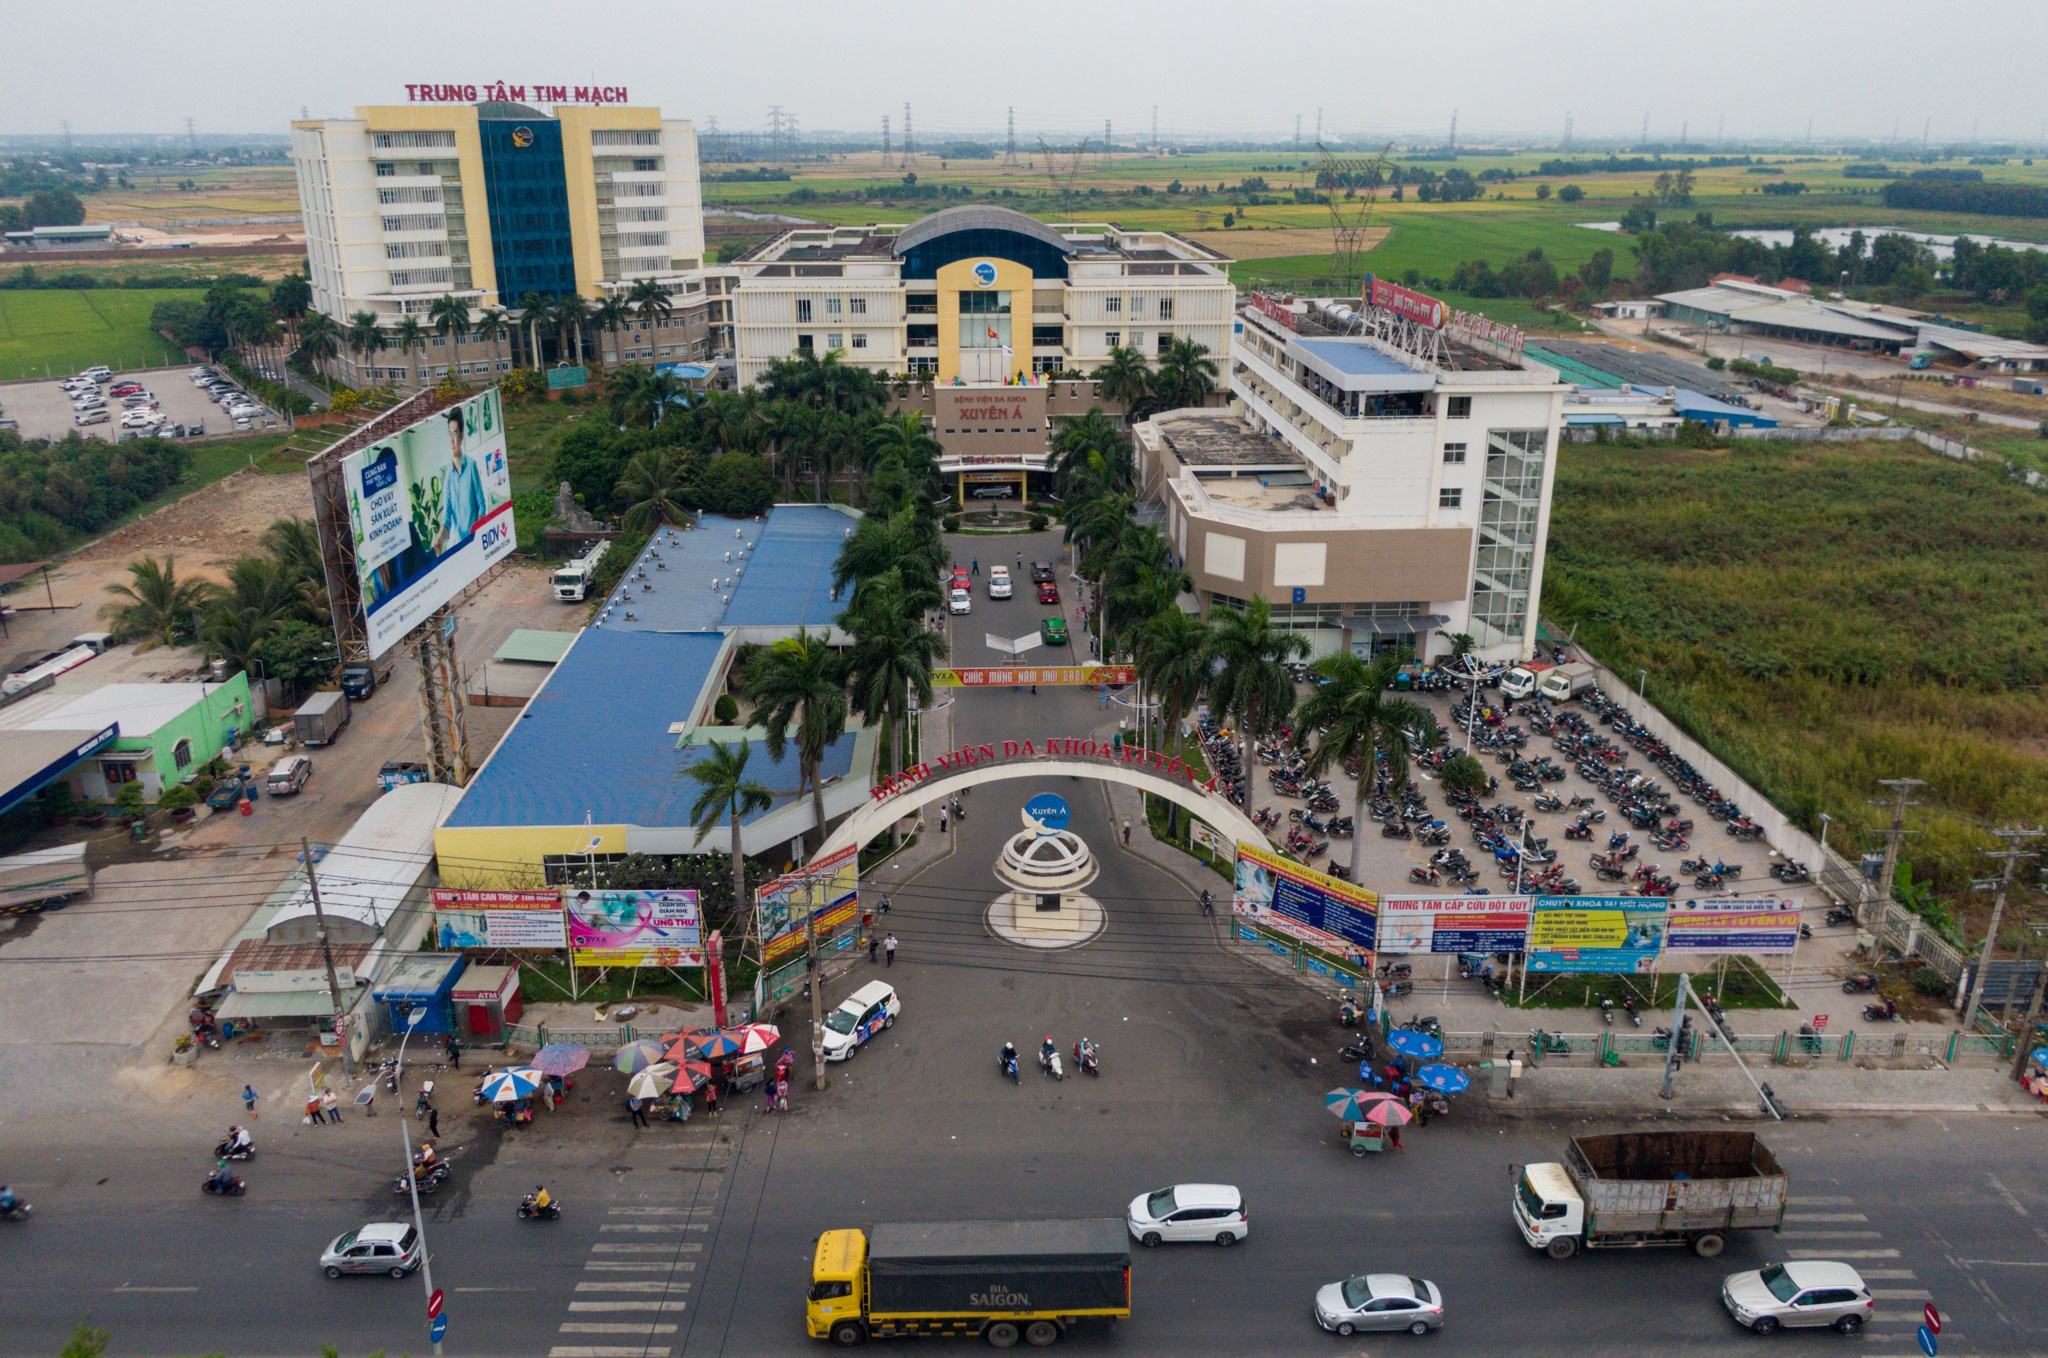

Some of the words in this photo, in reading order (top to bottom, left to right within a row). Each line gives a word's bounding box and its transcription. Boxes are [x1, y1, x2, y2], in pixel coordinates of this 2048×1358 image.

[405, 84, 477, 101] TRUNG
[483, 80, 526, 102] TÂM
[533, 86, 567, 102] TIM
[574, 86, 628, 106] MẠCH
[954, 396, 974, 404] BỆNH
[976, 395, 992, 403] VIỆN
[960, 406, 1008, 419] XUYÊN
[1012, 405, 1022, 419] Á
[370, 496, 382, 510] CHO
[382, 490, 394, 504] VAY
[371, 510, 382, 525] SẢN
[383, 502, 397, 516] XUẤT
[369, 528, 383, 542] KINH
[383, 515, 403, 531] DOANH
[482, 524, 500, 550] BIDV
[1293, 587, 1305, 604] B
[963, 670, 983, 683] CHÚC
[989, 669, 1013, 684] MỪNG
[1018, 668, 1037, 684] NĂM
[1043, 668, 1058, 682] MỚI
[1064, 670, 1085, 681] 2021
[868, 762, 933, 802] BỆNH
[936, 743, 994, 770] VIỆN
[1002, 739, 1036, 757] ĐA
[1046, 738, 1111, 759] KHOA
[1119, 744, 1200, 783] XUYÊN
[1200, 772, 1221, 793] Á
[1060, 806, 1066, 814] Á
[821, 857, 834, 869] BVXA
[848, 846, 856, 854] AN
[1242, 845, 1257, 856] PHẪU
[1259, 852, 1277, 865] THUẬT
[1278, 860, 1289, 869] TIM
[1294, 867, 1313, 880] MẠCH
[462, 891, 479, 901] TÂM
[762, 884, 780, 894] THÔNG
[1387, 901, 1418, 910] TRUNG
[1422, 900, 1442, 910] TÂM
[1445, 899, 1464, 910] CẤP
[1467, 899, 1485, 910] CỨU
[1488, 900, 1506, 912] ĐỘT
[1619, 900, 1636, 908] MŨI
[1638, 901, 1666, 910] HỌNG
[1673, 914, 1711, 928] BỆNH
[1713, 914, 1728, 925] LÝ
[1732, 912, 1777, 925] TUYẾN
[1778, 914, 1798, 925] VÚ
[1269, 917, 1282, 926] CON
[1325, 941, 1343, 953] TRANG
[970, 1293, 1028, 1305] SAIGON
